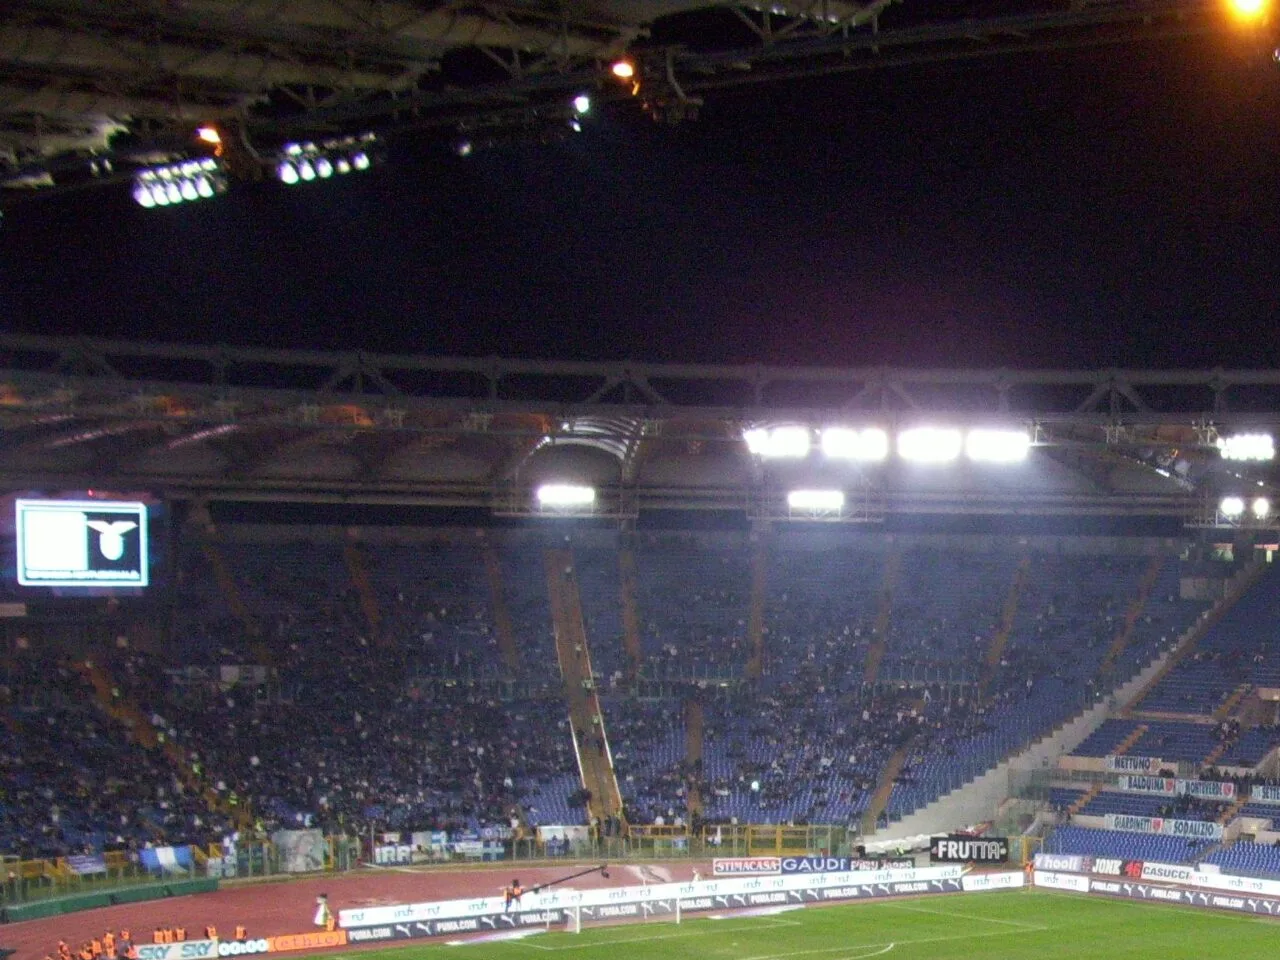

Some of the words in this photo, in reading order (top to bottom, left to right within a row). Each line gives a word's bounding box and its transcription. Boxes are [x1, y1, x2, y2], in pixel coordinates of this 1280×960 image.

[1115, 756, 1149, 770] NETTUNO
[1173, 820, 1214, 835] SODALIZIO
[937, 840, 1000, 860] FRUTTA
[716, 860, 778, 873] STIMACASA
[180, 942, 213, 958] SKY
